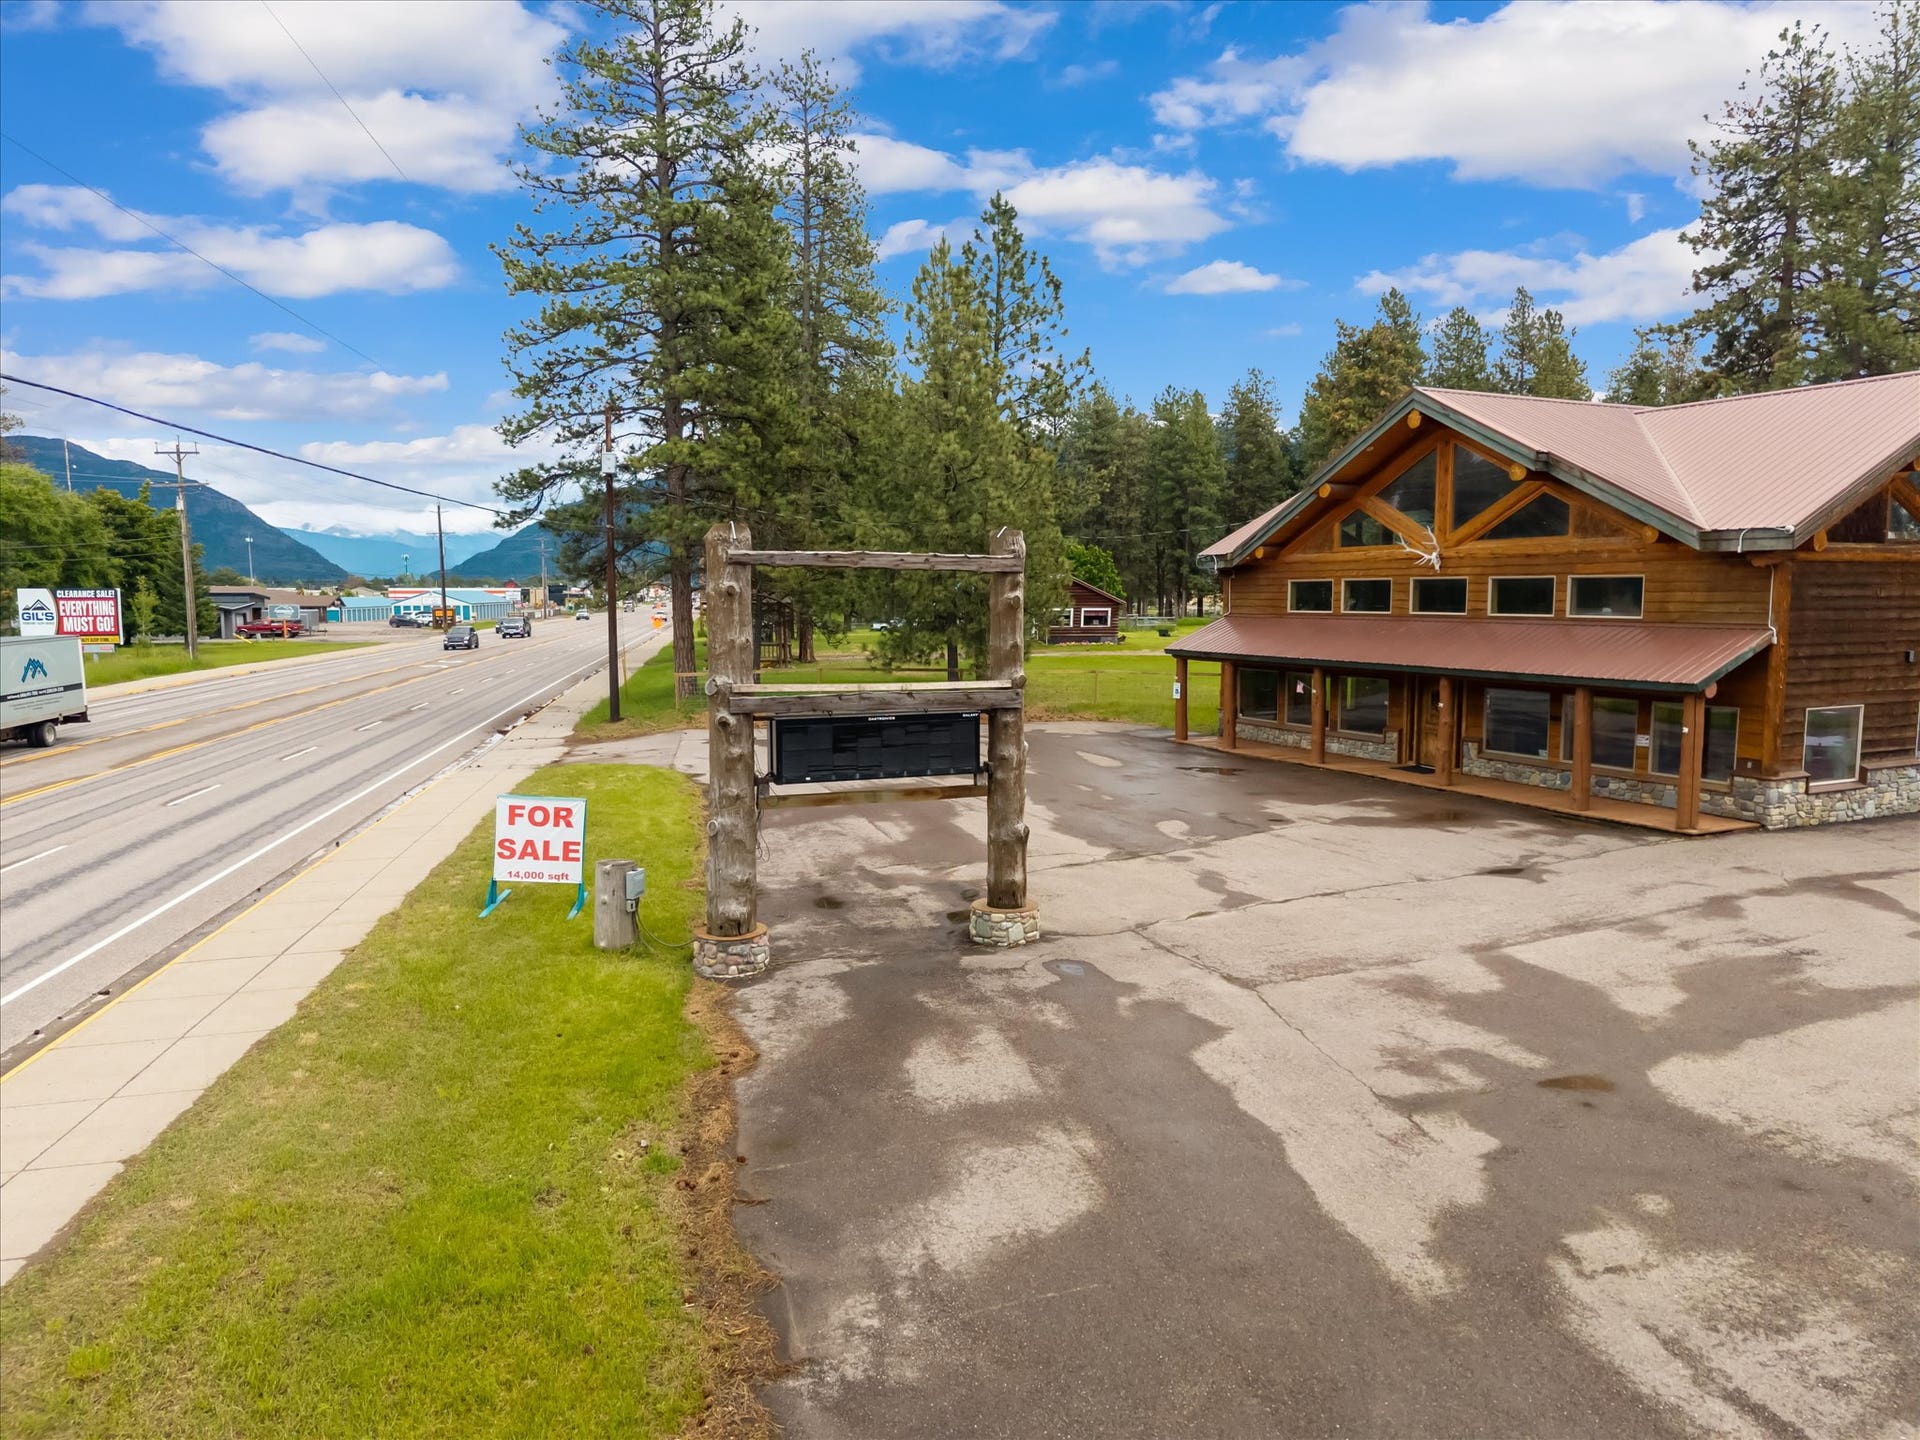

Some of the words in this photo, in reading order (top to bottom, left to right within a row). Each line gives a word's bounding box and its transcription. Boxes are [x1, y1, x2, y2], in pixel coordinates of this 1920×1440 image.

[56, 590, 95, 598] CLEARANCE
[59, 600, 115, 616] EVERYTHING
[21, 612, 54, 621] GIL'S
[63, 616, 94, 632] MUST
[96, 616, 115, 632] GO!
[508, 805, 574, 828] FOR
[497, 838, 581, 862] SALE
[507, 870, 544, 880] 14,000
[548, 872, 570, 882] sqft
